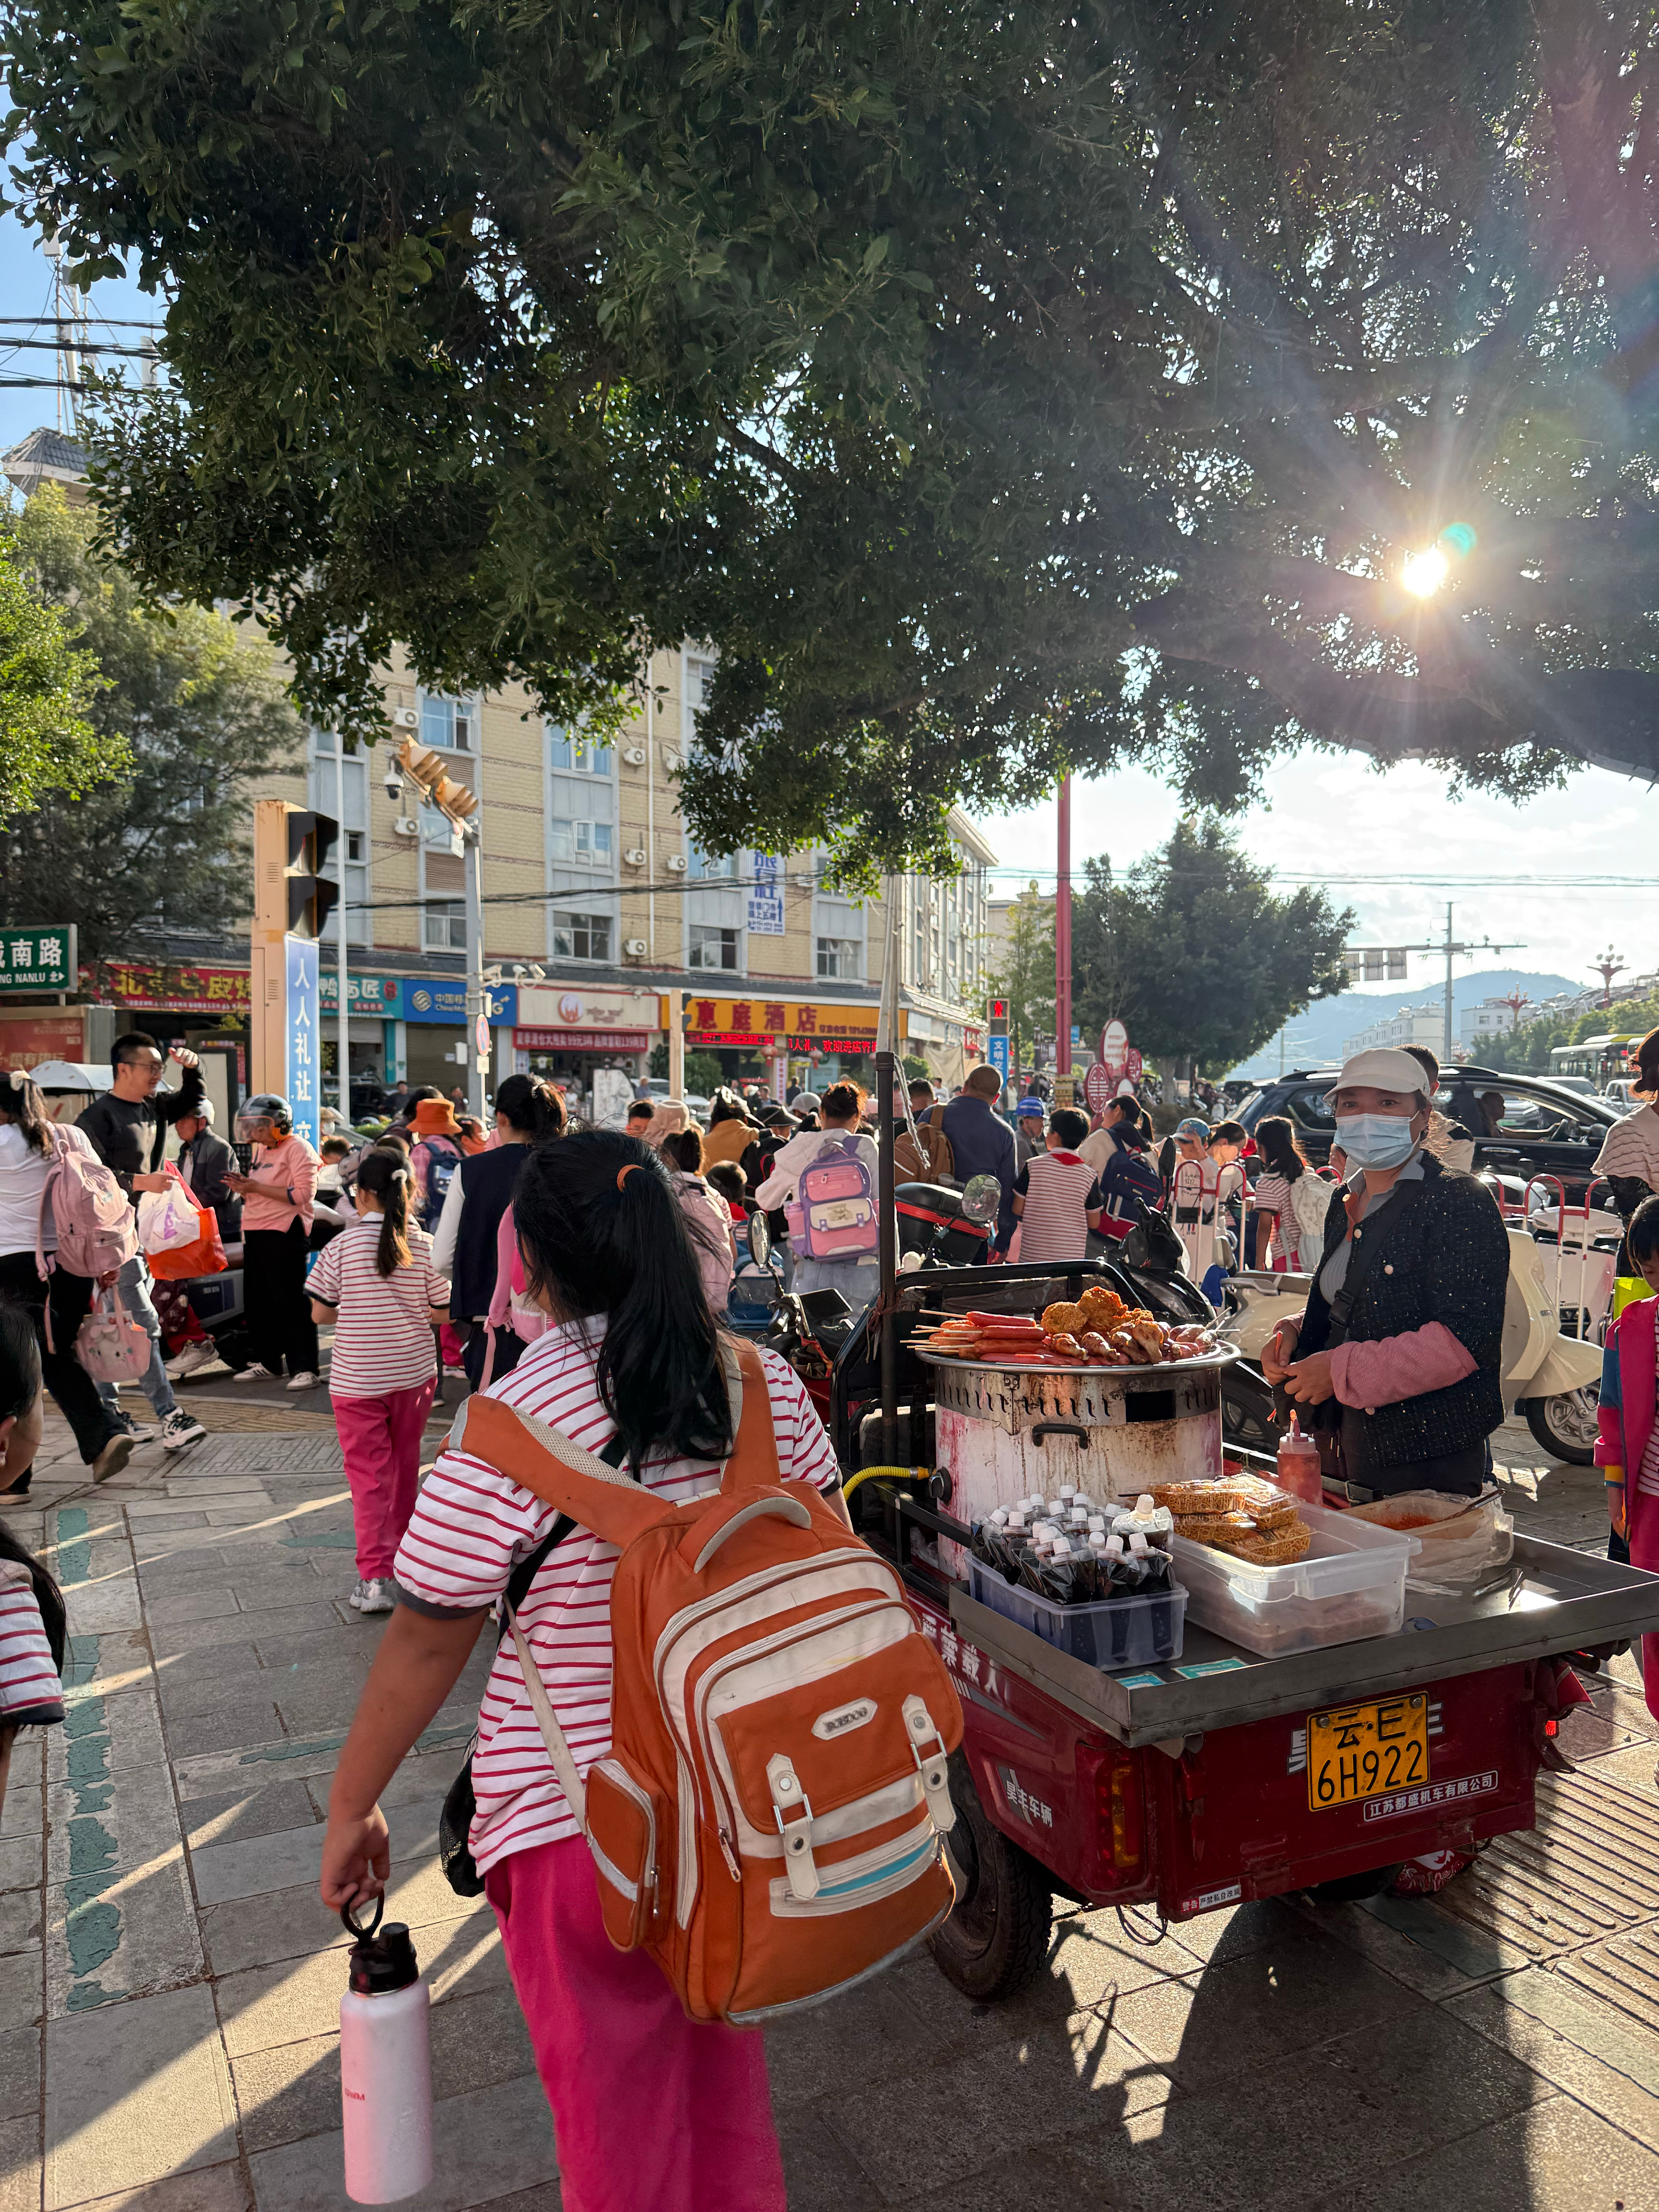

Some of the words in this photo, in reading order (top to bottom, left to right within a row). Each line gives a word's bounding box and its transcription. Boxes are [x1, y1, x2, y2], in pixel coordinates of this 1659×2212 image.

[0, 936, 62, 968] 南路
[15, 972, 46, 983] NANLU
[49, 971, 58, 982] 北
[294, 958, 311, 1101] 人人礼让
[1318, 1740, 1422, 1802] 6H922
